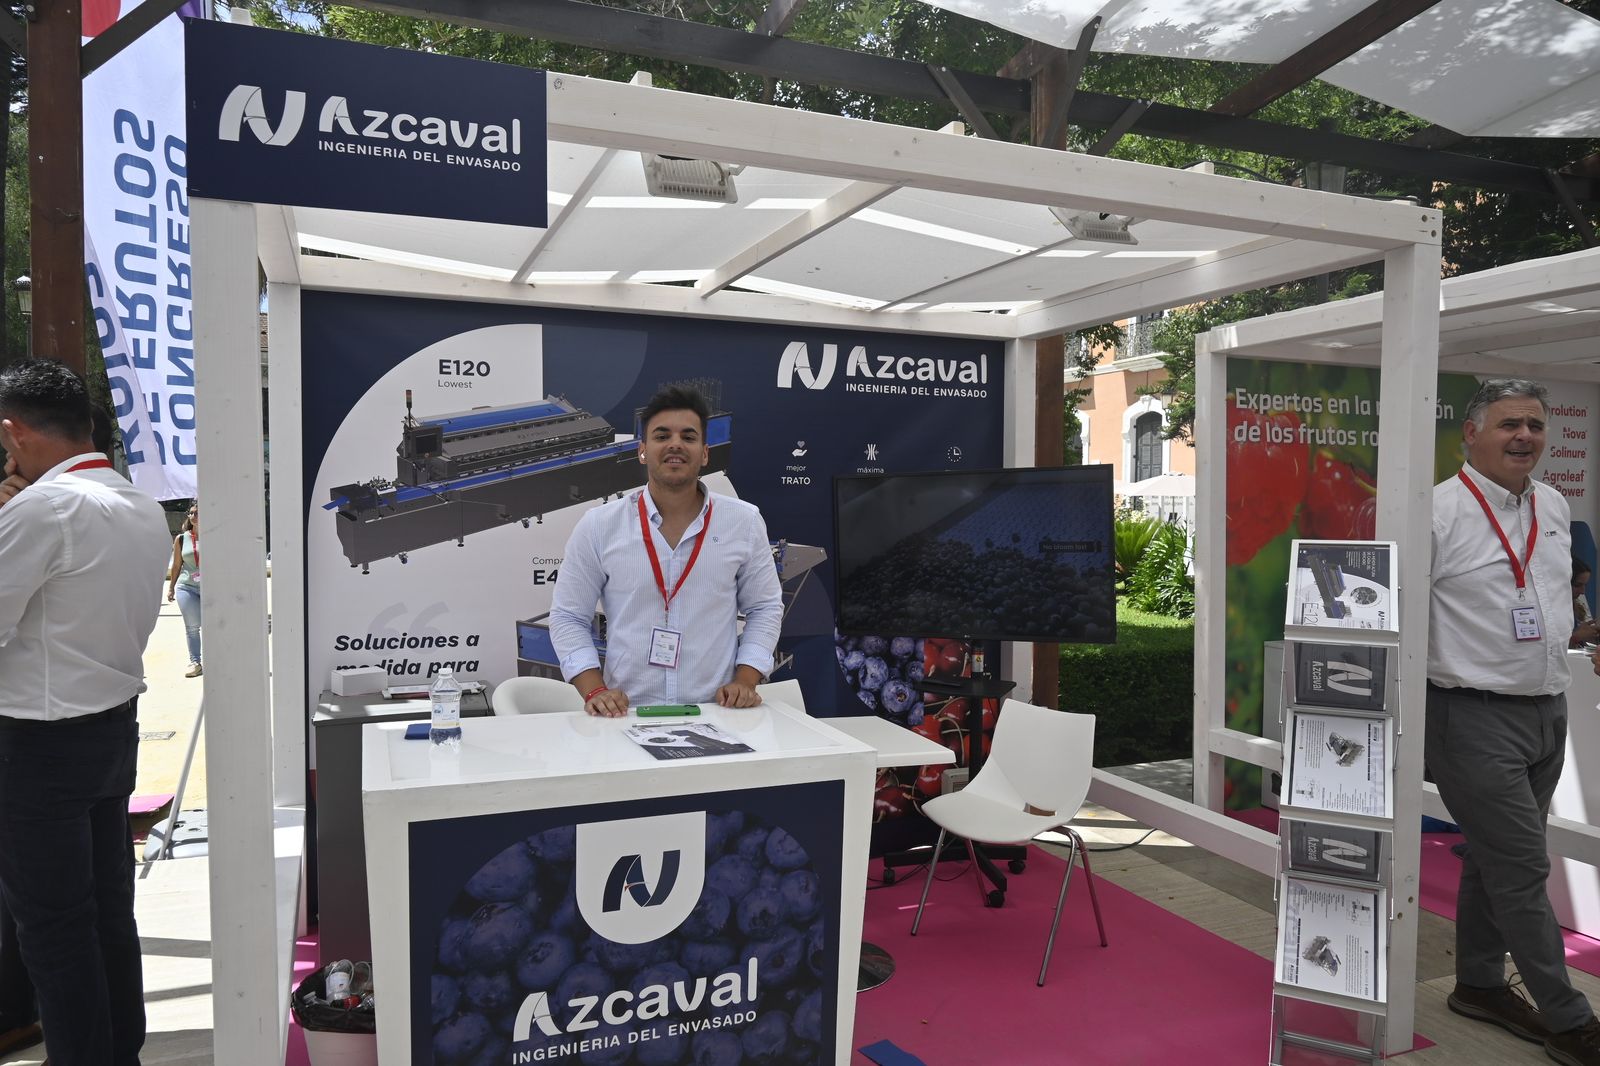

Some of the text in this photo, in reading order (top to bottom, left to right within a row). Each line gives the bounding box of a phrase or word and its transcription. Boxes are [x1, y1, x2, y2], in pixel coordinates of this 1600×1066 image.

[318, 96, 522, 155] Azcaval
[318, 140, 521, 171] INGENIERIA DEL ENVASADO
[438, 359, 491, 377] E120
[846, 346, 988, 384] Azcaval
[438, 380, 473, 389] Lowest
[845, 383, 987, 398] INGENIERIA DEL ENVASADO
[1235, 388, 1322, 414] Expertos
[1328, 396, 1350, 413] en
[1355, 396, 1371, 415] la
[1234, 421, 1260, 443] de
[1266, 422, 1293, 444] los
[1299, 424, 1356, 446] frutos
[1563, 427, 1586, 439] Nova
[1550, 446, 1586, 458] Solinure
[786, 463, 806, 473] mejor
[857, 465, 884, 473] máxima
[1543, 469, 1584, 485] Agroleaf
[781, 476, 811, 485] TRATO
[334, 632, 480, 650] Soluciones a
[427, 659, 480, 678] para
[1312, 660, 1324, 691] Azcaval
[511, 957, 758, 1042] Azcaval
[512, 1011, 757, 1065] INGENIERIA DEL ENVASADO
